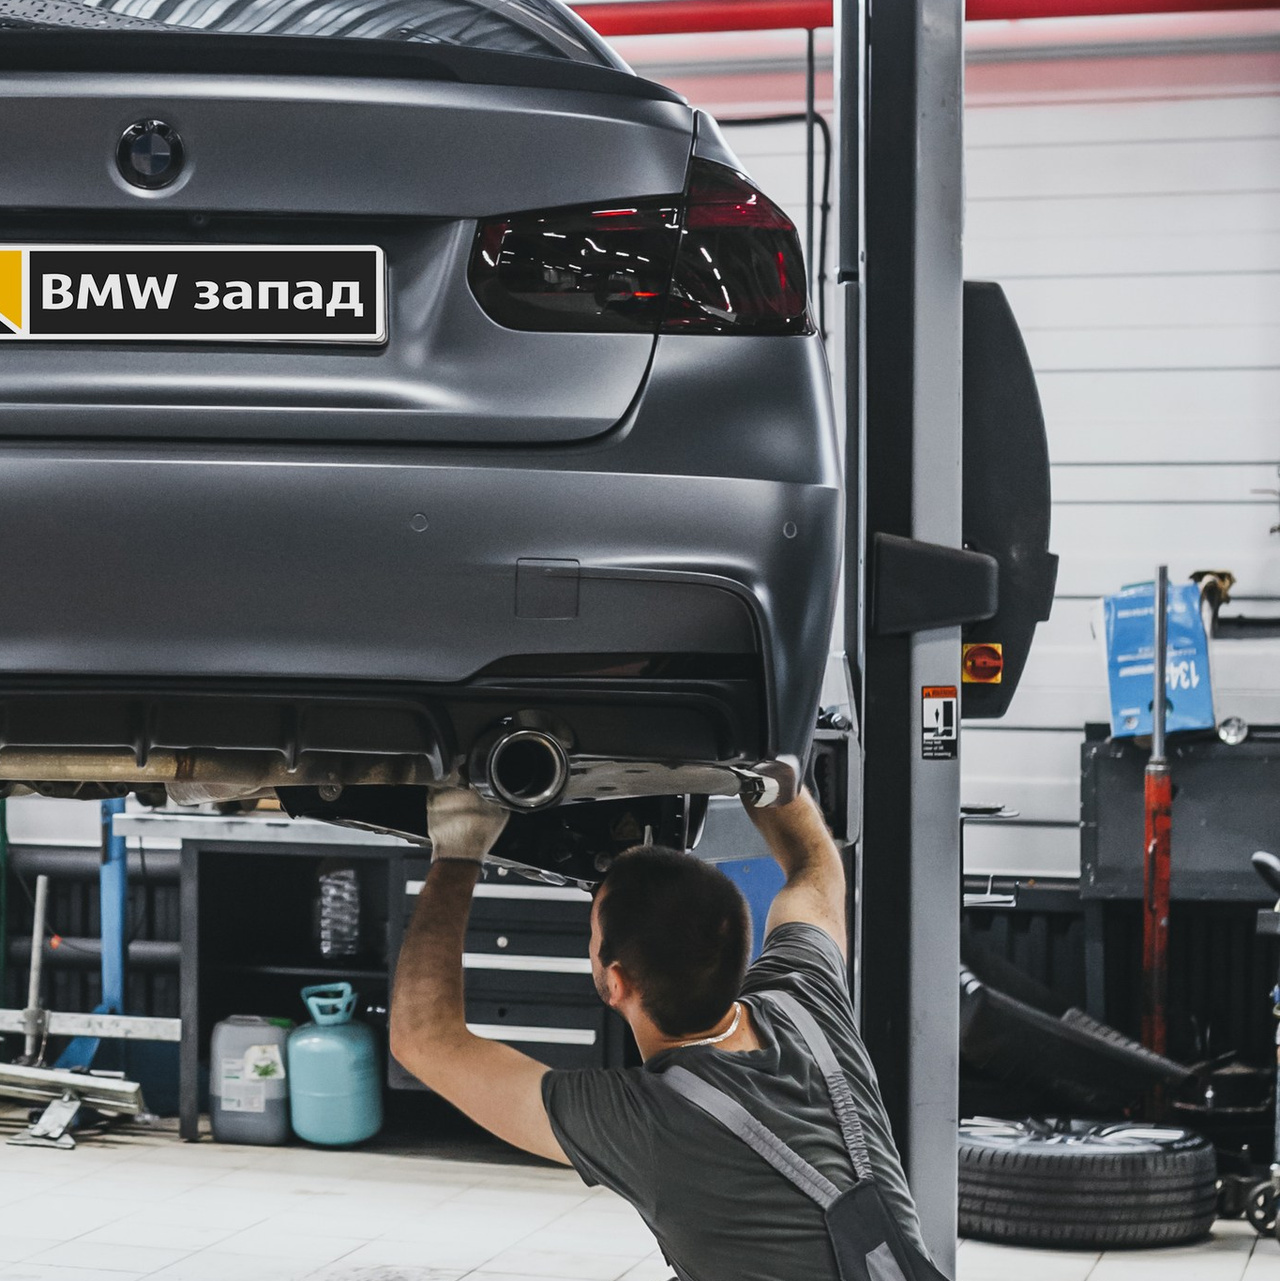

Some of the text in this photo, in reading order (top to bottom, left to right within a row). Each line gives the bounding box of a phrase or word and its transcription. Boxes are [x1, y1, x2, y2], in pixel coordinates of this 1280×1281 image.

[41, 273, 364, 318] BMW запад
[1165, 660, 1200, 691] 134
